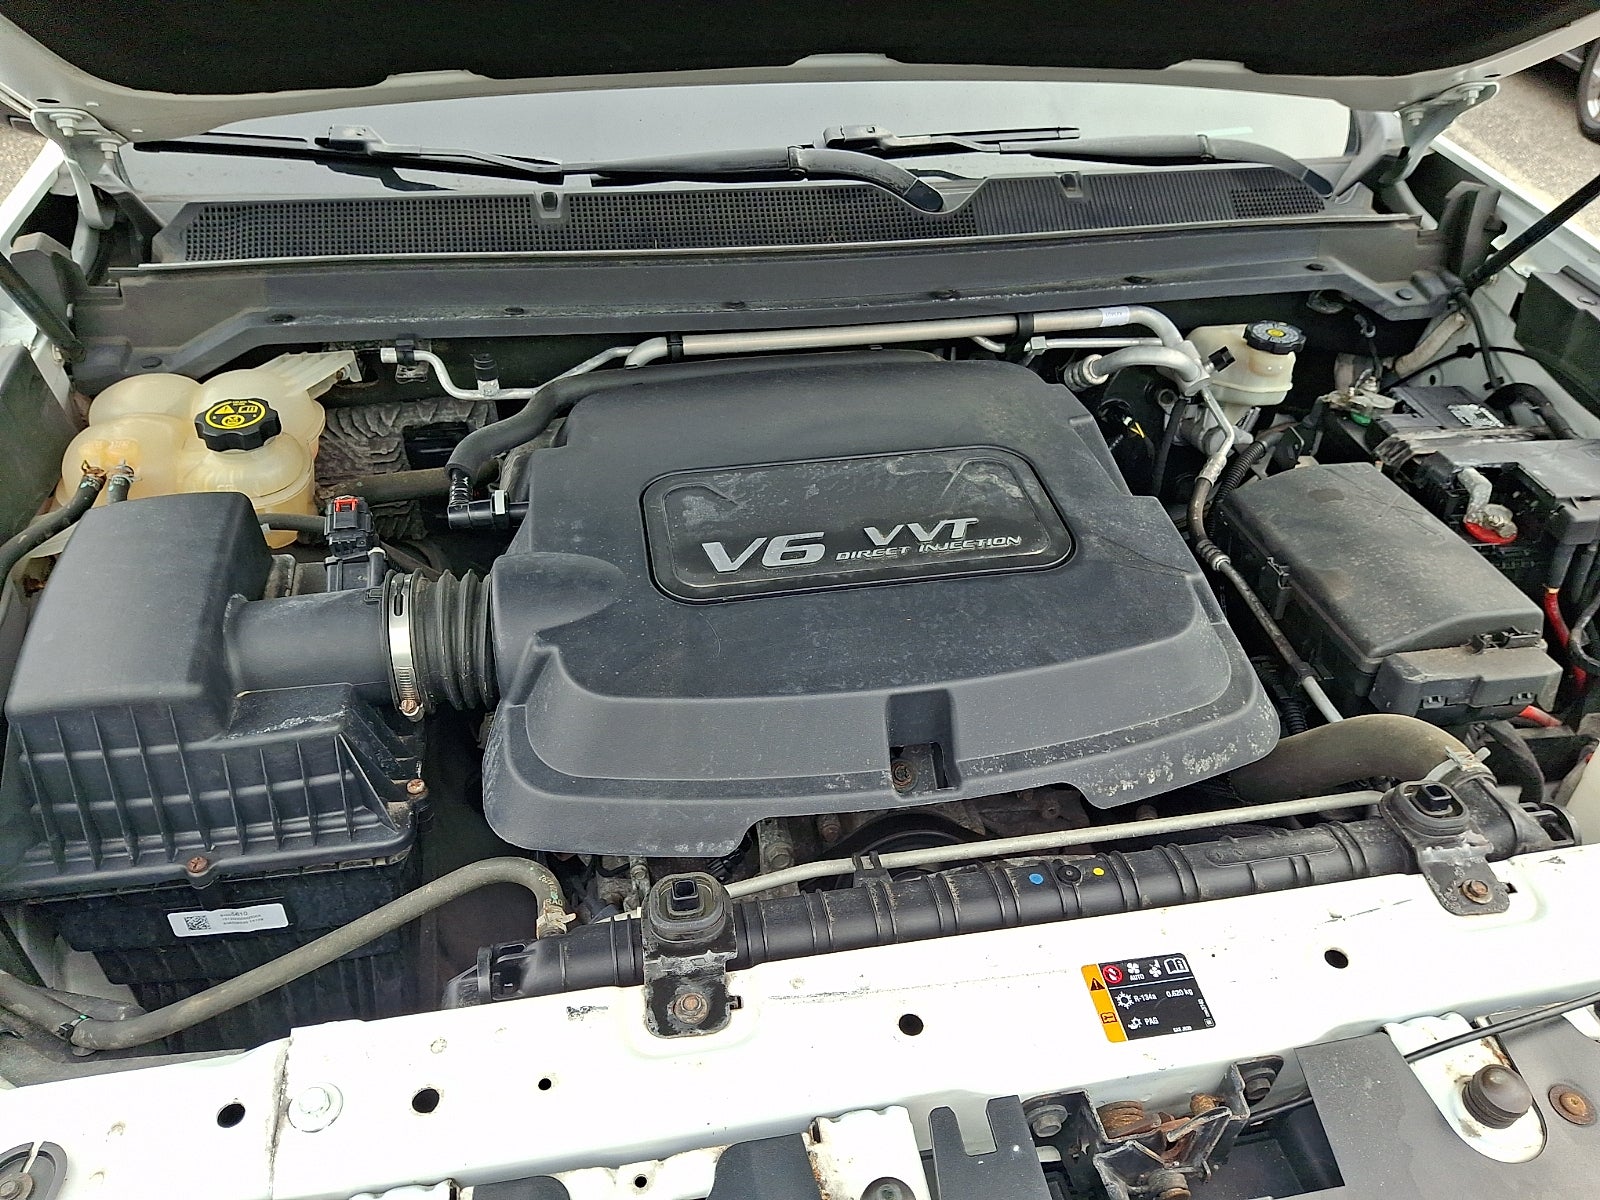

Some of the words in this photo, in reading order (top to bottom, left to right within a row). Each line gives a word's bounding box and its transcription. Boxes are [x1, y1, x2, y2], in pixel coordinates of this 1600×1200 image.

[701, 531, 826, 573] V6
[863, 517, 980, 546] VVT
[835, 546, 911, 561] DIRECT
[918, 535, 1022, 553] INJECTION
[1133, 993, 1157, 1002] R-134a
[1184, 988, 1194, 996] kg
[1144, 1017, 1159, 1025] PAG
